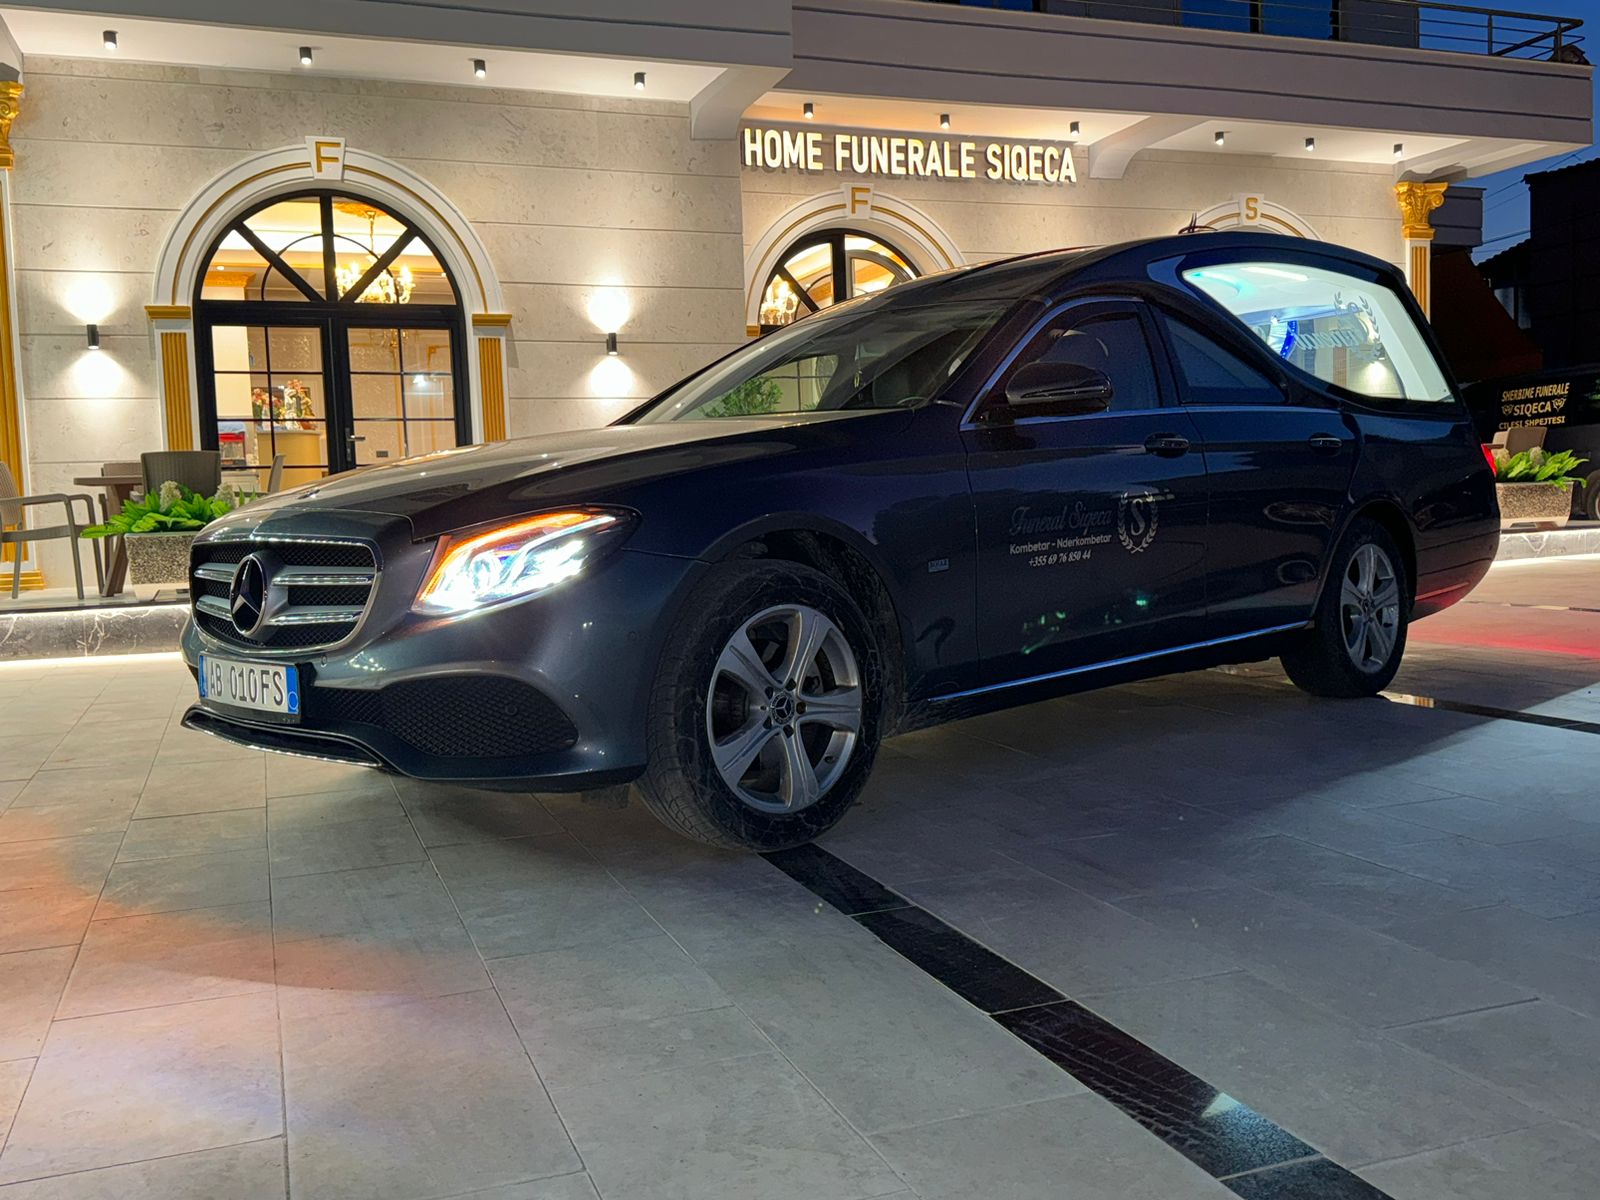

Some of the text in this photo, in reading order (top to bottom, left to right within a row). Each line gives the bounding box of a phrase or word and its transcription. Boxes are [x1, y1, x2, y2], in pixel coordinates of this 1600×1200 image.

[315, 141, 341, 173] F
[744, 128, 1077, 182] HOME FUNERALE SIQECA
[851, 187, 871, 214] F
[1246, 197, 1258, 220] S
[1535, 382, 1570, 398] FUNERALE
[1513, 401, 1552, 417] SIQECA
[1525, 416, 1566, 428] SHPEJTESI
[1009, 505, 1067, 536] Funeral
[1130, 498, 1146, 536] S
[1009, 541, 1051, 555] Kombetar
[1057, 533, 1112, 548] Nderkombetar
[1028, 555, 1047, 568] +355
[1048, 553, 1057, 565] 69
[1058, 552, 1067, 564] 76
[1082, 549, 1091, 560] 44
[210, 661, 223, 697] AB
